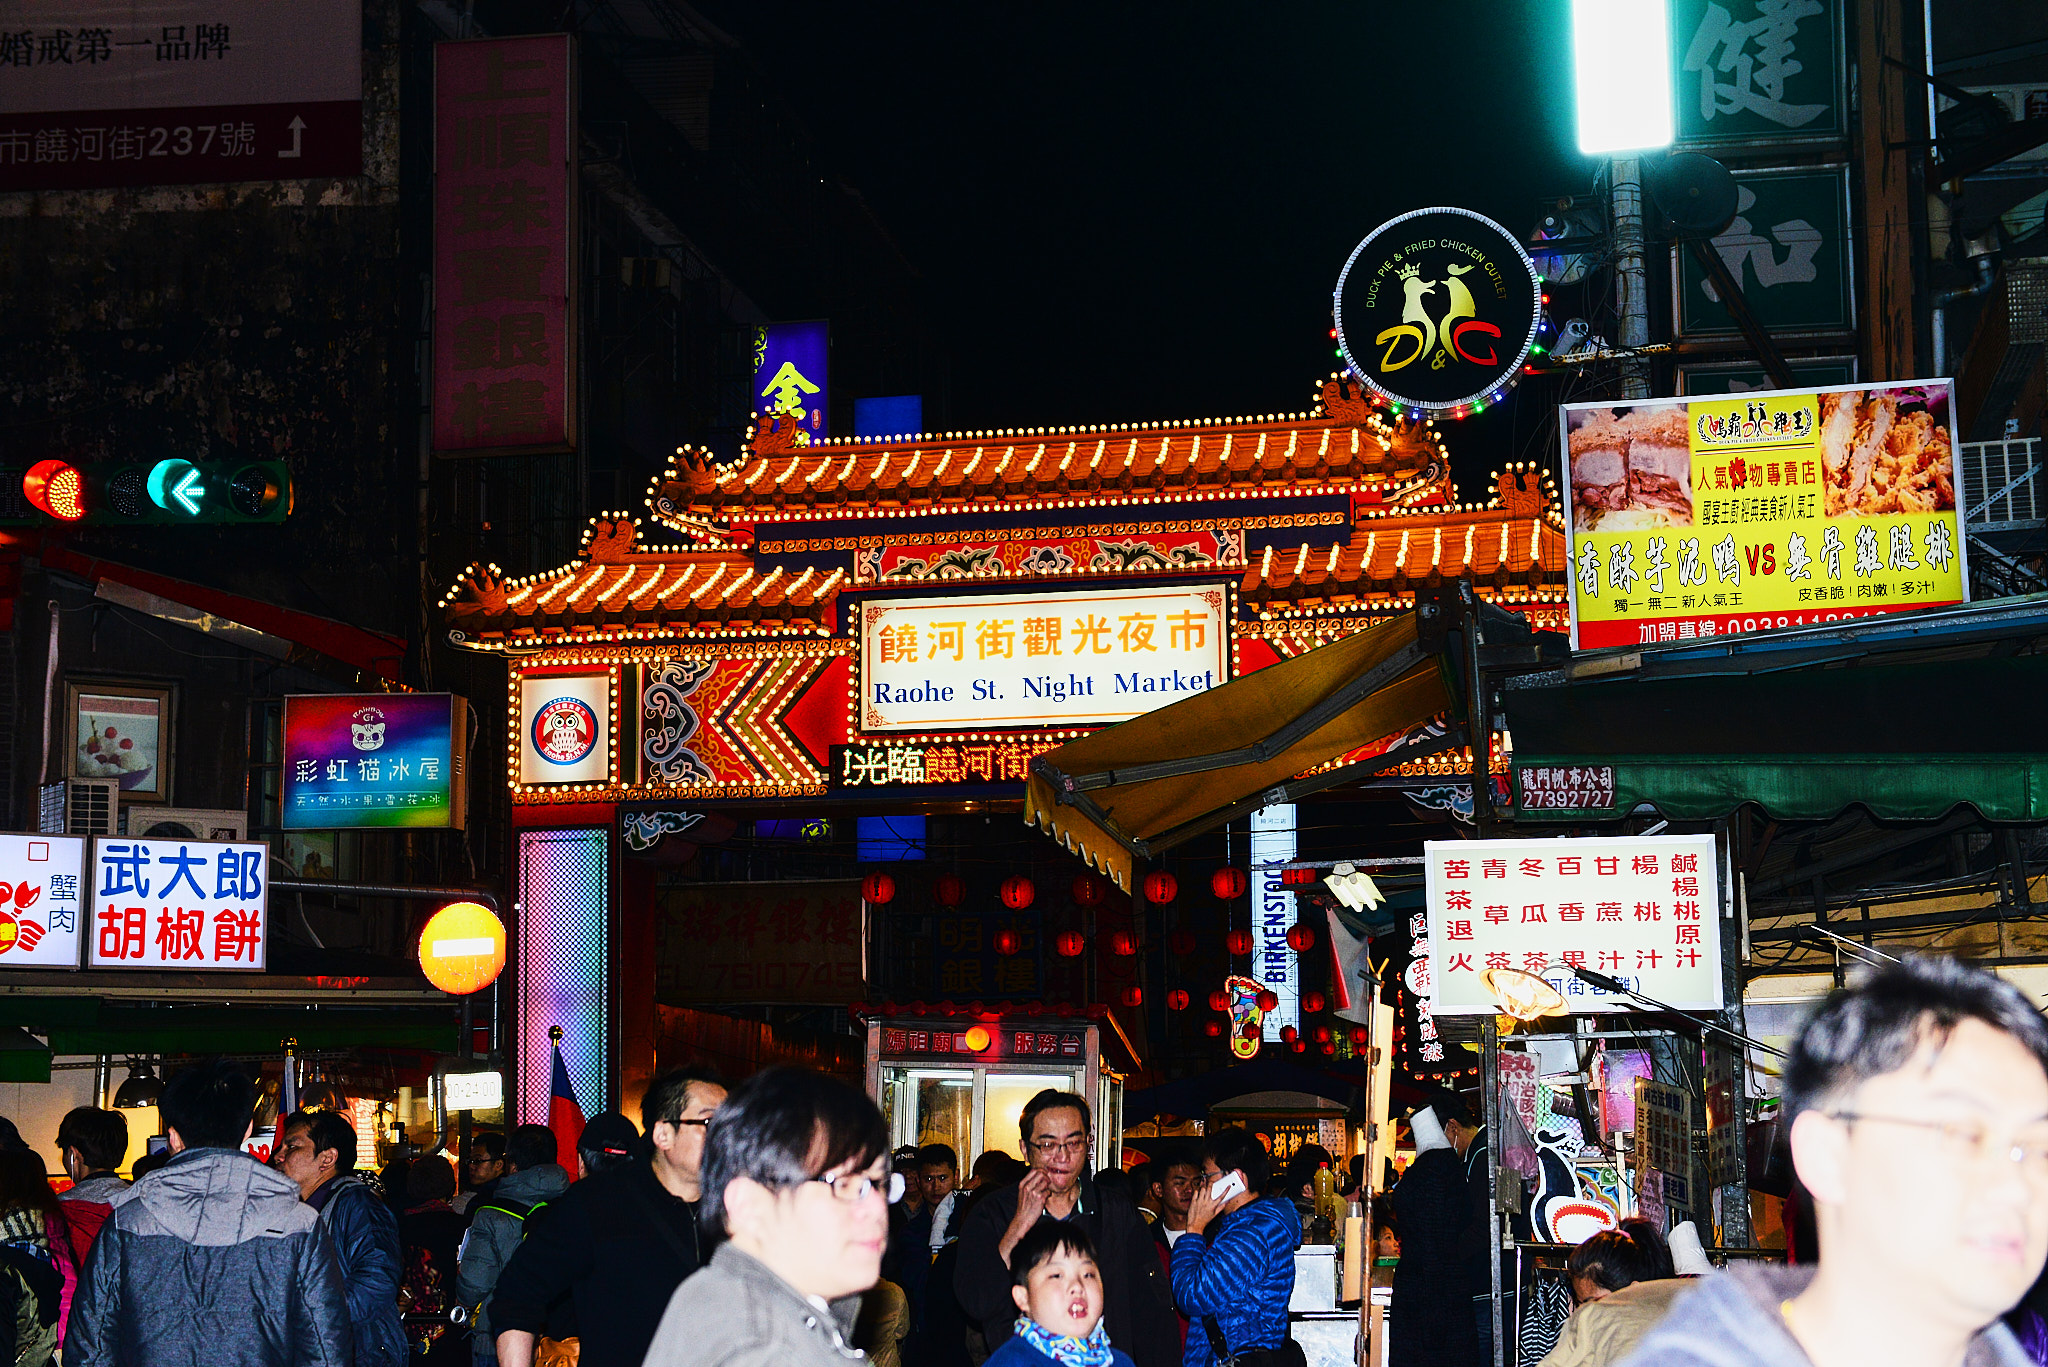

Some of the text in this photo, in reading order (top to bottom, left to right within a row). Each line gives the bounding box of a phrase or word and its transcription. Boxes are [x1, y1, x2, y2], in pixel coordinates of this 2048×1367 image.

[0, 24, 231, 67] 婚戒第一品牌
[1366, 239, 1507, 308] DUCK PIE & FRIED CHICKEN CUTLET
[1698, 457, 1816, 492] 人氣炸物專賣店
[1744, 543, 1776, 577] VS
[1785, 519, 1954, 581] 無骨雞腿排
[1614, 592, 1743, 613] 獨一無二新人氣王
[878, 608, 1210, 664] 饒河街觀光夜市
[874, 669, 1214, 705] Raohe St. Night Market
[1521, 766, 1615, 790] 龍門帆布公司
[1523, 791, 1614, 809] 27392727
[100, 844, 262, 901] 武大郎
[48, 874, 77, 934] 蟹肉
[98, 903, 261, 962] 胡椒餅
[1444, 859, 1475, 973] 苦茶退火
[1481, 858, 1512, 970] 青草茶
[1518, 857, 1549, 970] 冬瓜茶
[1557, 856, 1588, 969] 百香果
[1593, 855, 1625, 970] 甘蔗汁
[1631, 854, 1664, 969] 楊桃汁
[1670, 853, 1703, 968] 鹹楊桃原汁
[1014, 1031, 1082, 1057] 服務台
